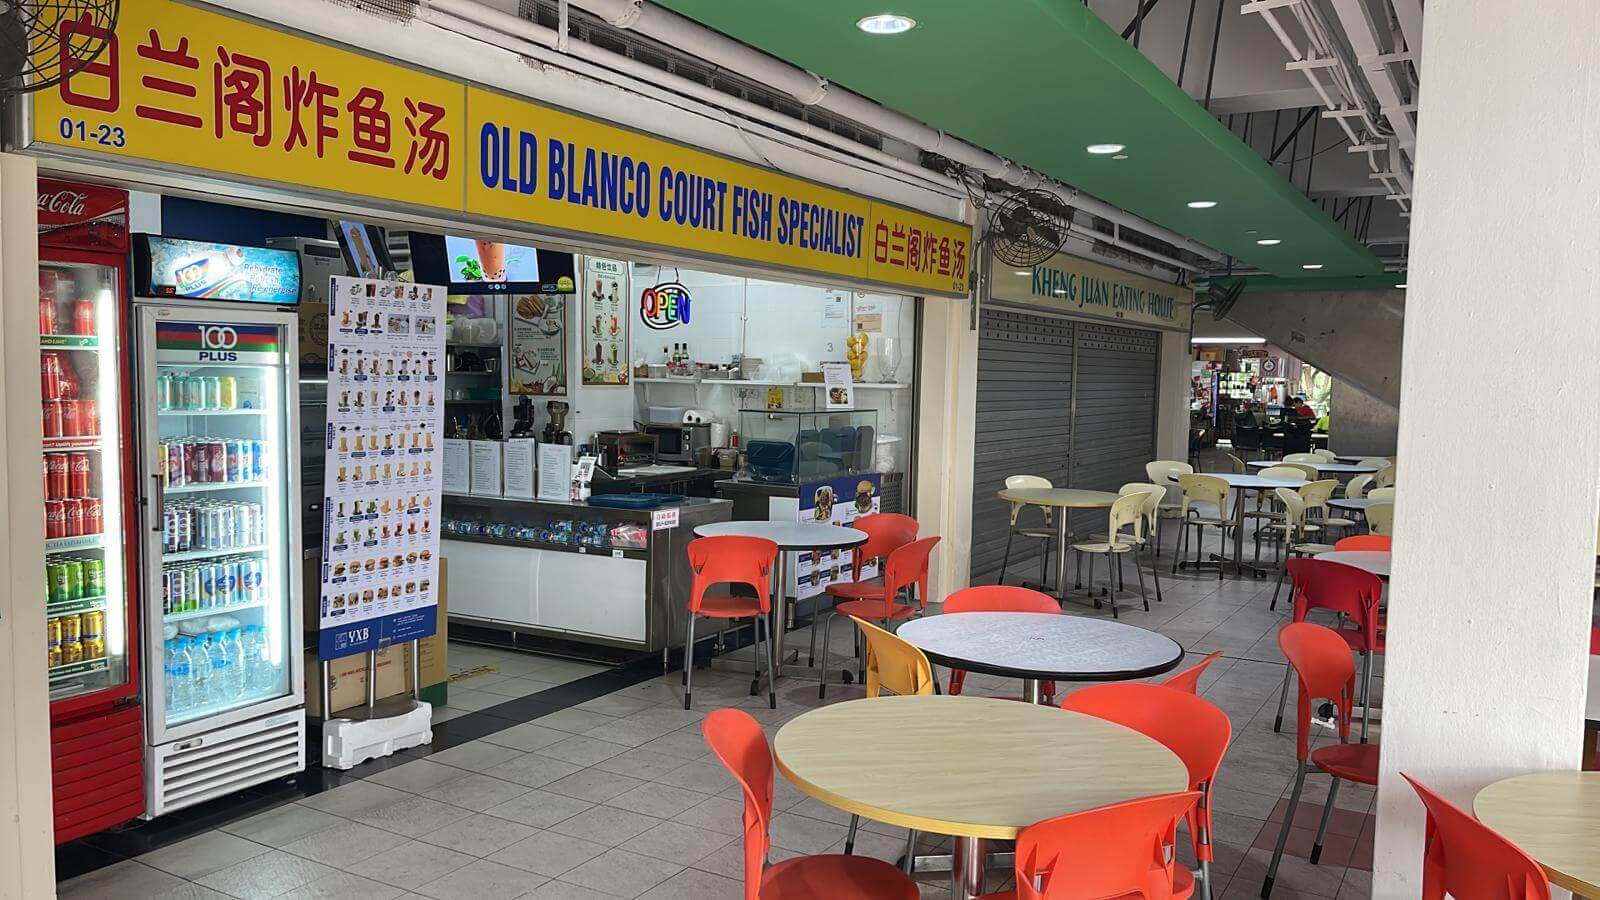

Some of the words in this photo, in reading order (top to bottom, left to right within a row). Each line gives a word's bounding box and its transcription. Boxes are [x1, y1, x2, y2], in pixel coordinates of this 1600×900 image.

[59, 13, 450, 181] 白兰阁炸鱼汤
[59, 117, 127, 148] 01-23
[480, 121, 537, 195] OLD
[548, 138, 651, 218] BLANCO
[659, 166, 728, 234] COURT
[732, 185, 773, 238] FISH
[778, 197, 864, 259] SPECIALIST
[875, 218, 965, 279] 白兰阁炸鱼汤
[244, 263, 283, 274] Rehydrate
[642, 288, 691, 324] OPEN
[1032, 266, 1076, 300] KHENG
[1079, 276, 1109, 308] JUAN
[1112, 284, 1145, 314] EATING
[198, 326, 238, 349] 100
[199, 351, 238, 362] PLUS
[348, 627, 369, 642] YXB
